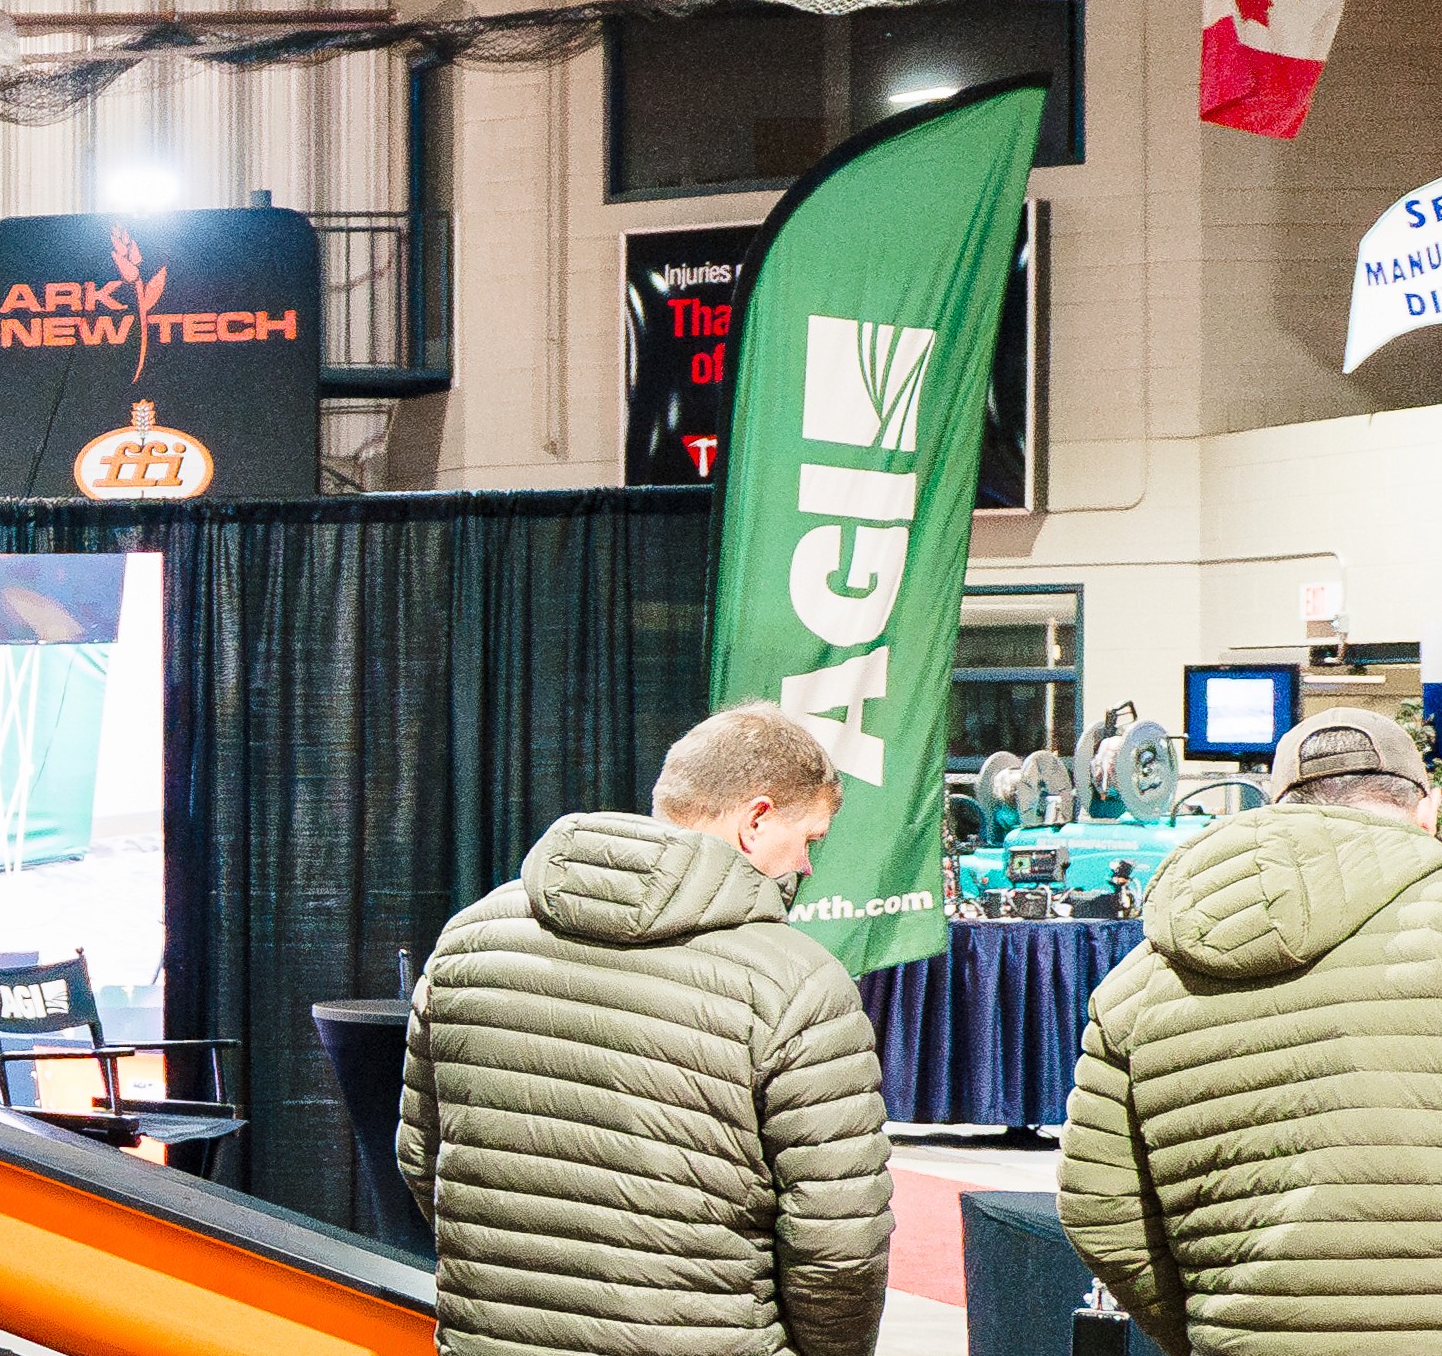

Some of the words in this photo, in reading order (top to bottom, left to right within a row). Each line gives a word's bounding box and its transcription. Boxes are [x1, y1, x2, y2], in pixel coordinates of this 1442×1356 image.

[663, 260, 732, 291] Injuries
[0, 314, 135, 349] NEW
[146, 309, 298, 344] TECH
[92, 440, 187, 488] ffi
[779, 463, 917, 788] AGI
